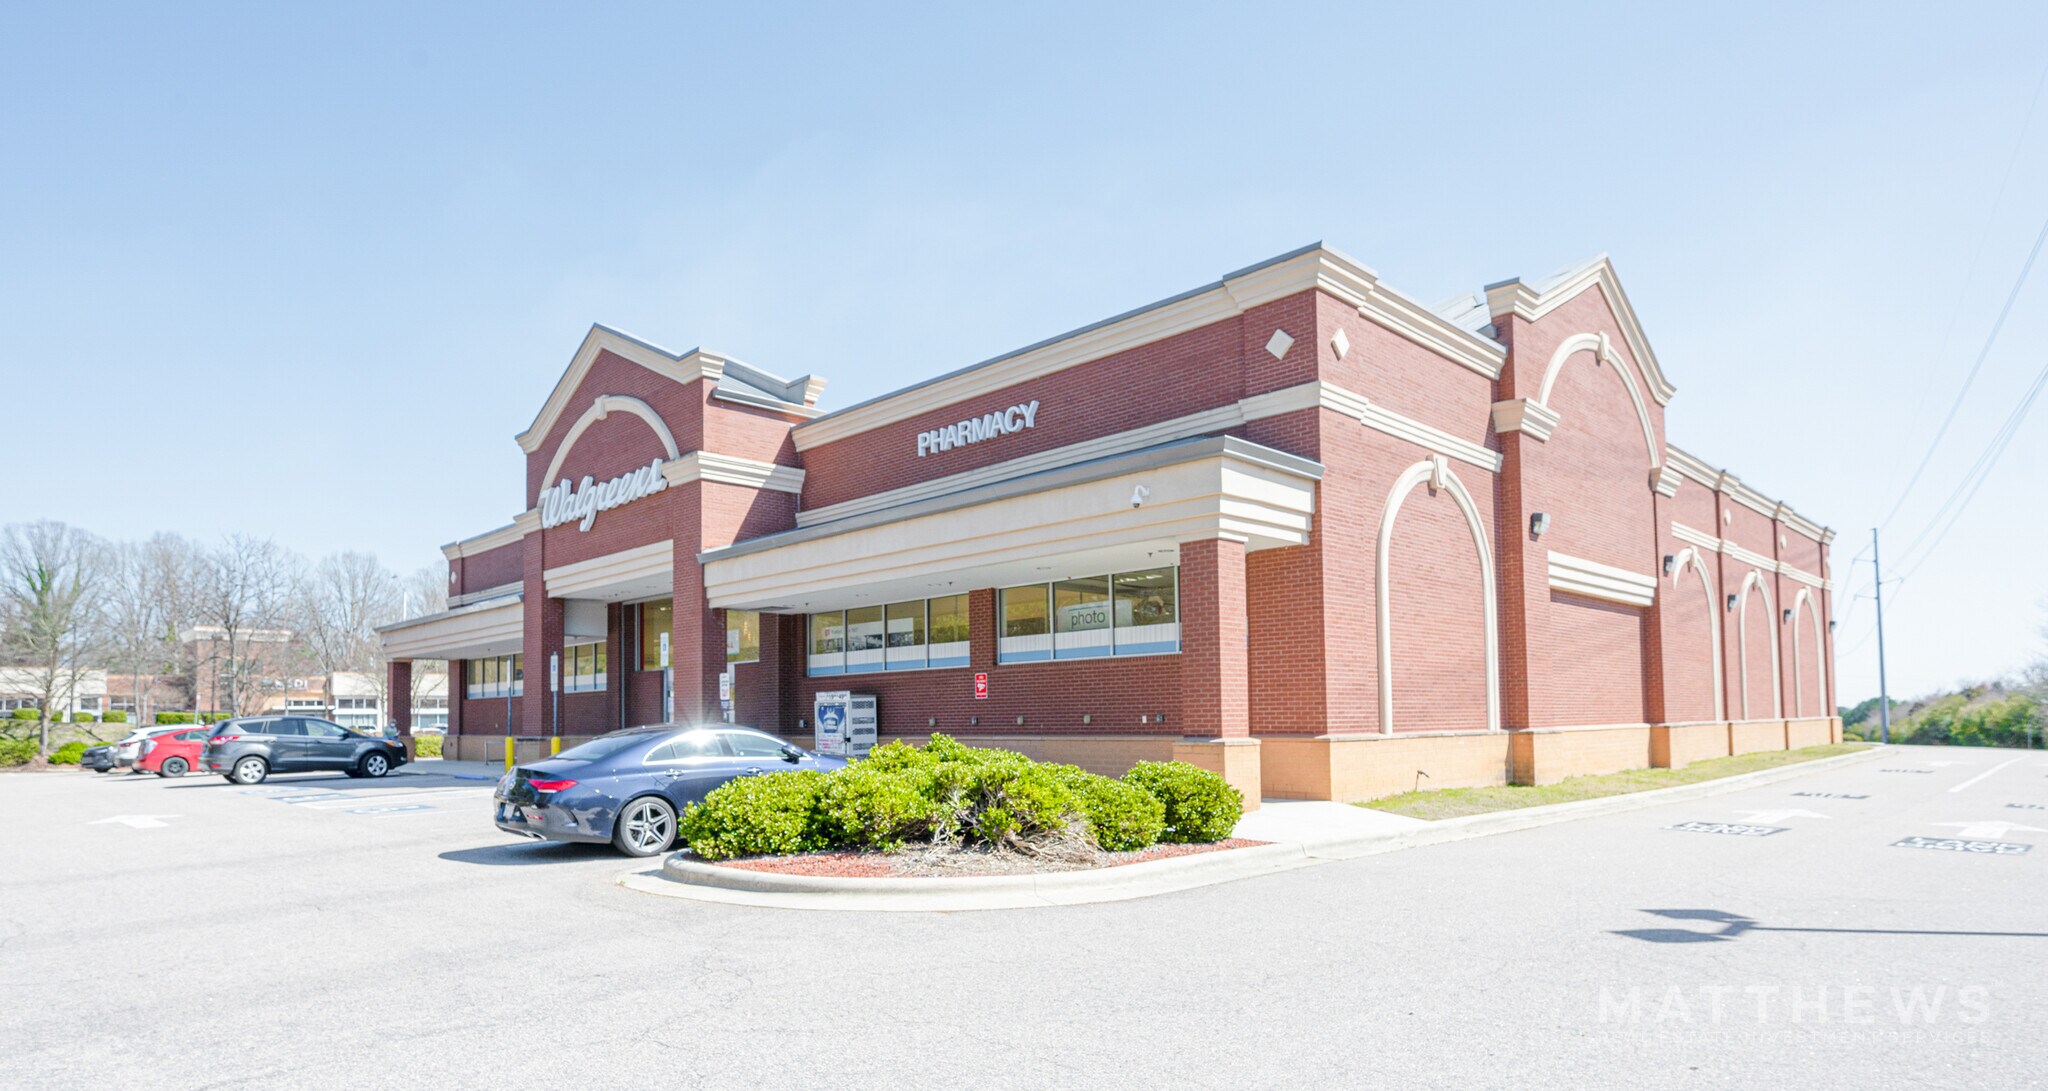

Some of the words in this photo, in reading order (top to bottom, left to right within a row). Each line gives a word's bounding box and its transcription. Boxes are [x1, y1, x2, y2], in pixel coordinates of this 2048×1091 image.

[918, 400, 1040, 457] PHARMACY
[540, 458, 668, 532] Walgreens
[1071, 610, 1106, 630] photo
